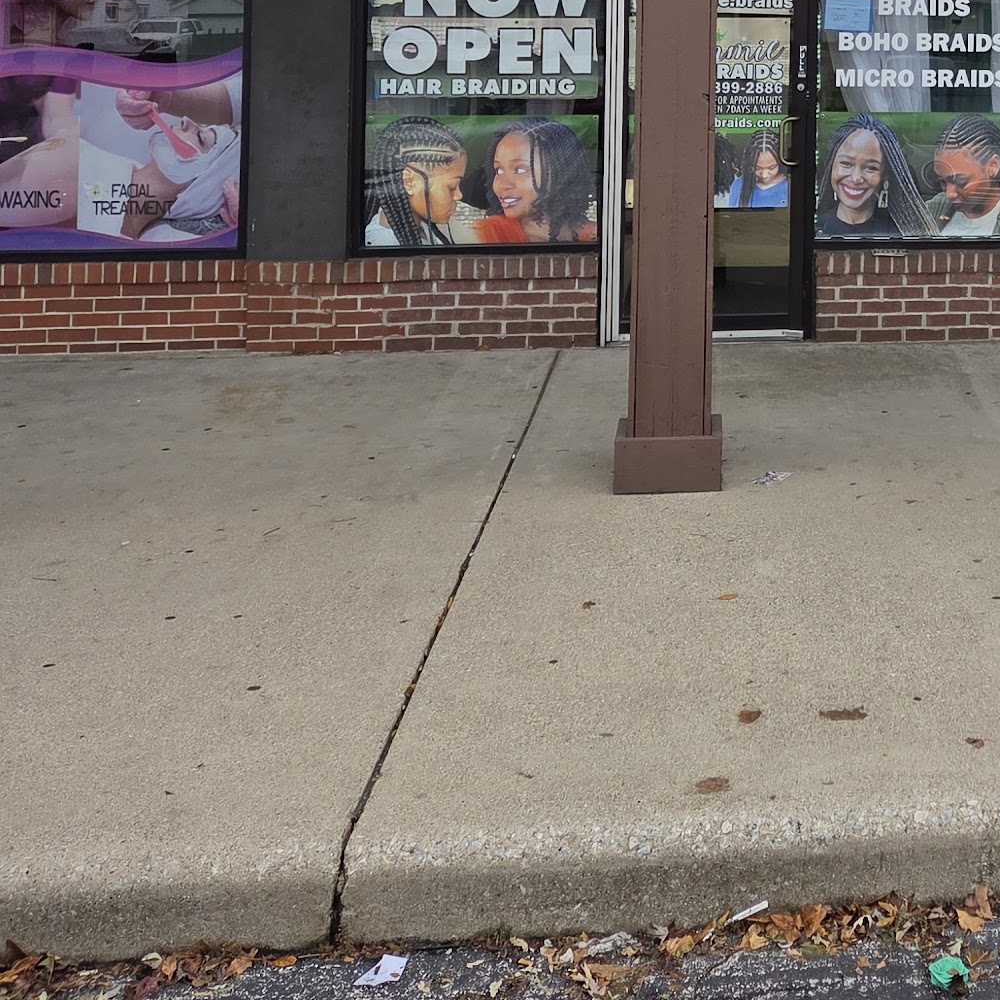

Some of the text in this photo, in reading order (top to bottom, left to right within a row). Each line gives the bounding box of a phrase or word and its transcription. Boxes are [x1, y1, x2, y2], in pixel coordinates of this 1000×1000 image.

[838, 32, 909, 51] BOHO
[382, 26, 593, 75] OPEN
[716, 63, 783, 80] RAIDS
[834, 68, 915, 88] MICRO
[380, 78, 576, 95] HAIR BRAIDING
[715, 96, 783, 105] OR APPOINTMENTS
[752, 105, 759, 114] A
[760, 105, 782, 114] WEEK
[0, 190, 61, 209] WAXING
[111, 184, 157, 198] FACIAL
[92, 201, 172, 216] TREATMENT
